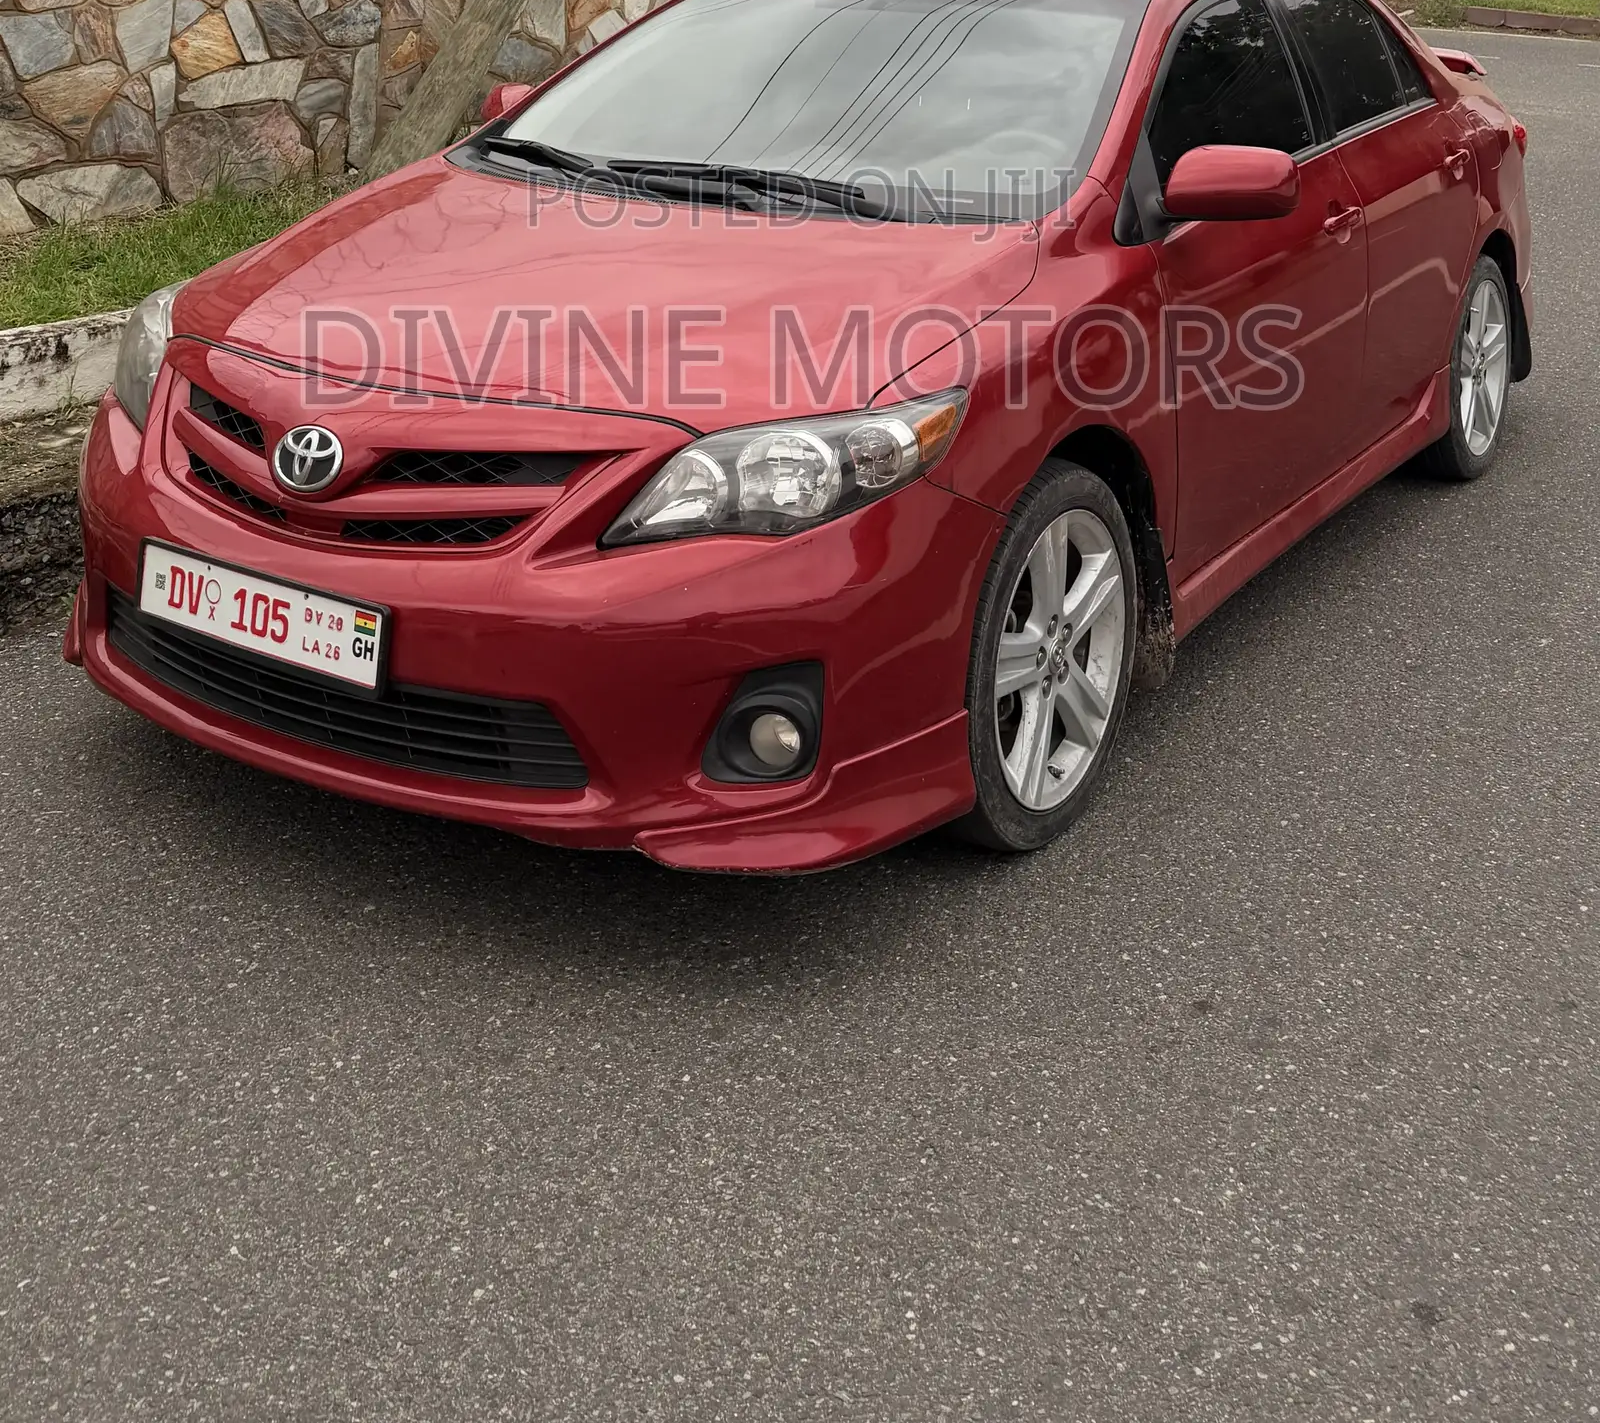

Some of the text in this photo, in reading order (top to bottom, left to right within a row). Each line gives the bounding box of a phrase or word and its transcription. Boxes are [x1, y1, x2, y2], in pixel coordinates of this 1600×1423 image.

[168, 565, 291, 644] DV 105
[302, 636, 341, 661] LA 26
[352, 637, 375, 662] GH
